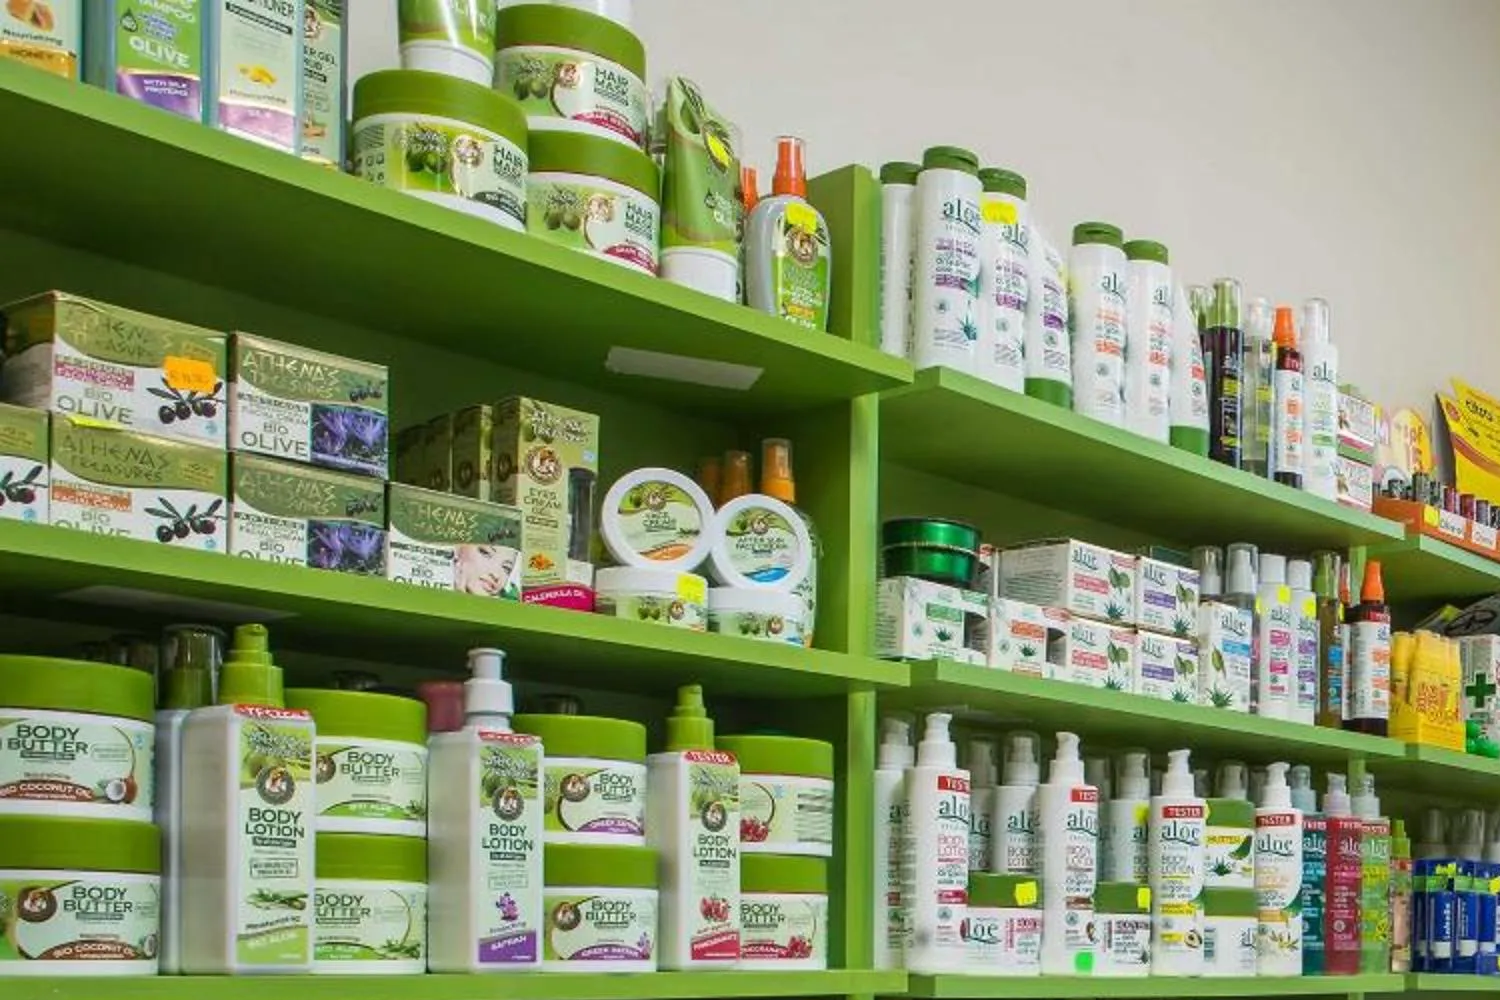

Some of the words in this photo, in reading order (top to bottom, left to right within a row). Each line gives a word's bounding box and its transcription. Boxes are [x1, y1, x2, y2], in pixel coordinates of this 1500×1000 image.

[130, 36, 191, 68] OLIVE
[593, 66, 630, 82] HAIR
[593, 77, 630, 96] MASK
[493, 145, 524, 167] HAIR
[625, 200, 655, 220] HAIR
[624, 211, 655, 231] MASK
[84, 387, 113, 401] BIO
[57, 395, 134, 425] OLIVE
[264, 422, 289, 435] BIO
[241, 431, 308, 456] OLIVE
[82, 510, 111, 524] BIO
[259, 541, 285, 554] BIO
[411, 567, 434, 577] BIO
[1221, 613, 1247, 630] aloe
[16, 724, 80, 740] BODY
[7, 738, 89, 754] BUTTER
[346, 751, 396, 767] BODY
[340, 762, 400, 777] BUTTER
[599, 773, 634, 786] BODY
[19, 782, 73, 793] COCONUT
[593, 783, 637, 796] BUTTER
[248, 807, 302, 825] BODY
[1167, 807, 1200, 817] TESTER
[1259, 816, 1291, 825] TESTER
[245, 821, 305, 838] LOTION
[488, 823, 527, 839] BODY
[1160, 821, 1199, 841] aloe
[481, 838, 534, 852] LOTION
[696, 833, 729, 847] BODY
[1256, 835, 1293, 851] aloe
[692, 846, 737, 859] LOTION
[72, 886, 128, 900] BODY
[315, 893, 365, 908] BODY
[63, 899, 133, 913] BUTTER
[317, 904, 371, 919] UTTER
[591, 900, 632, 913] BODY
[740, 903, 780, 917] BODY
[585, 910, 637, 923] BUTTER
[76, 942, 122, 953] COCONUT
